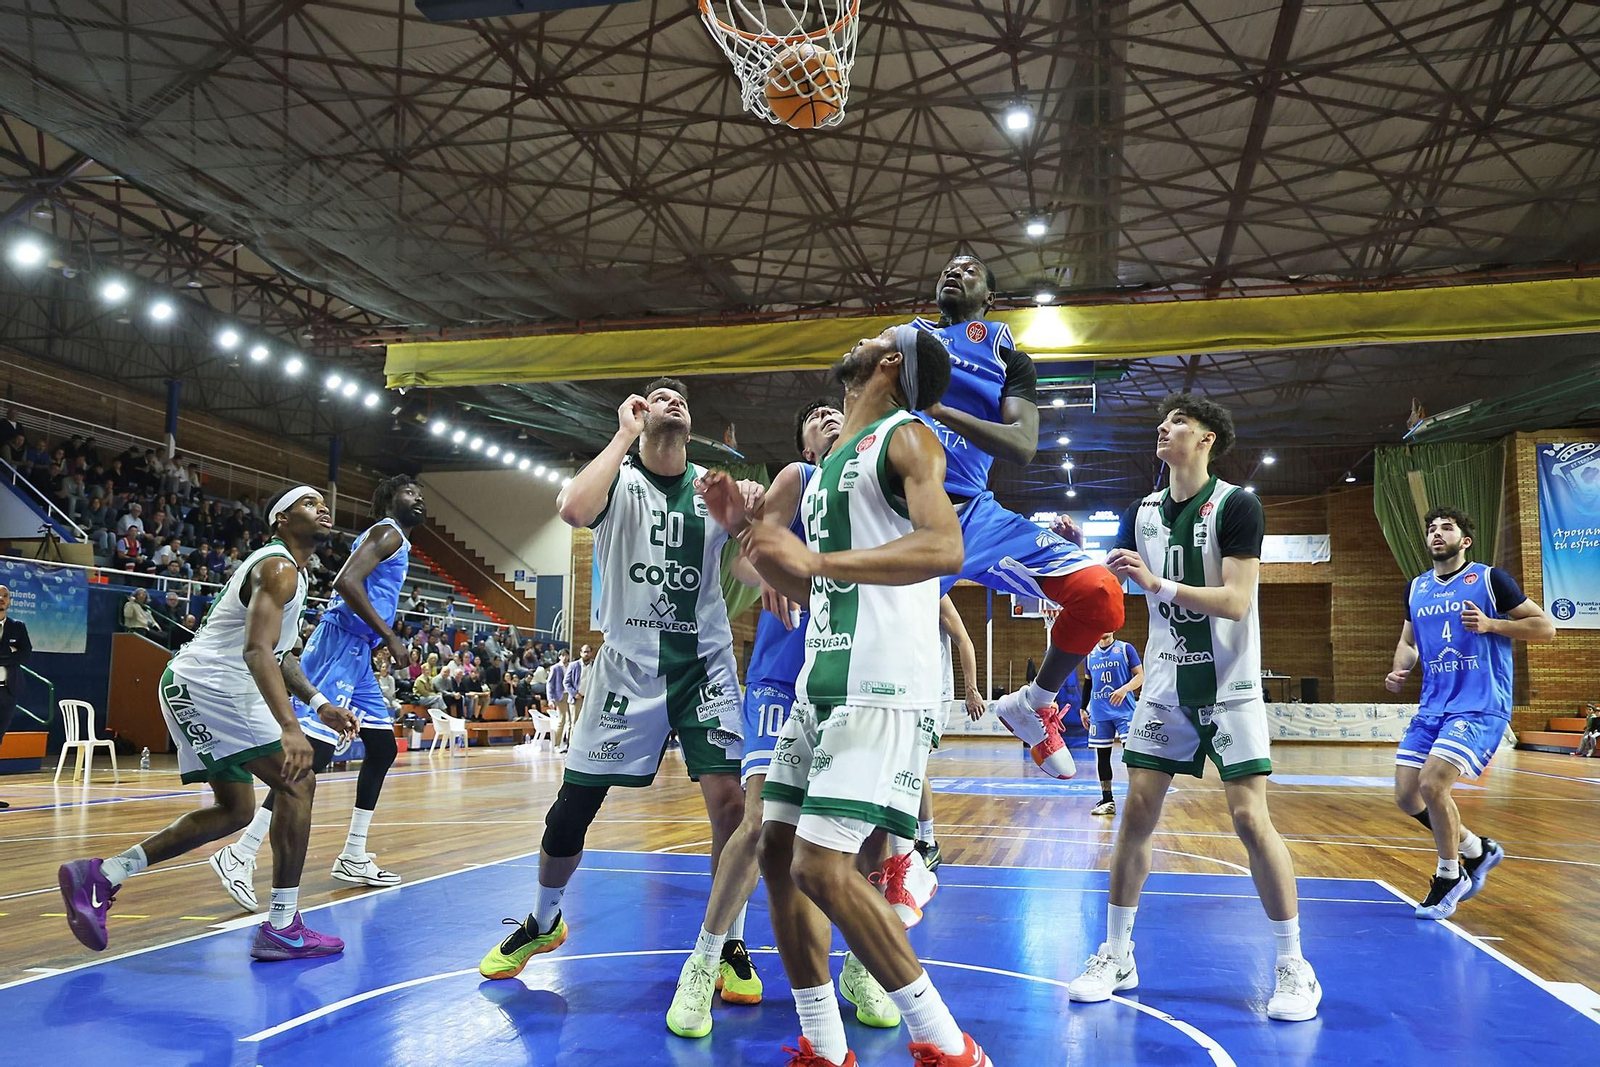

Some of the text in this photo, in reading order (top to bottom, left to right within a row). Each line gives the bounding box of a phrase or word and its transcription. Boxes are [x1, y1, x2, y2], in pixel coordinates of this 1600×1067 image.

[807, 489, 829, 542] 22
[650, 509, 685, 548] 20
[1554, 541, 1568, 551] tu
[629, 562, 700, 590] coto
[625, 618, 697, 632] ATRESVEGA
[1441, 621, 1452, 643] 4
[1430, 660, 1479, 674] EMERITA
[1100, 670, 1112, 684] 40
[698, 699, 734, 713] Diputación
[600, 714, 628, 724] Hospital
[758, 703, 784, 737] 10
[1133, 728, 1170, 743] IMDECO
[588, 750, 625, 760] IMDECO
